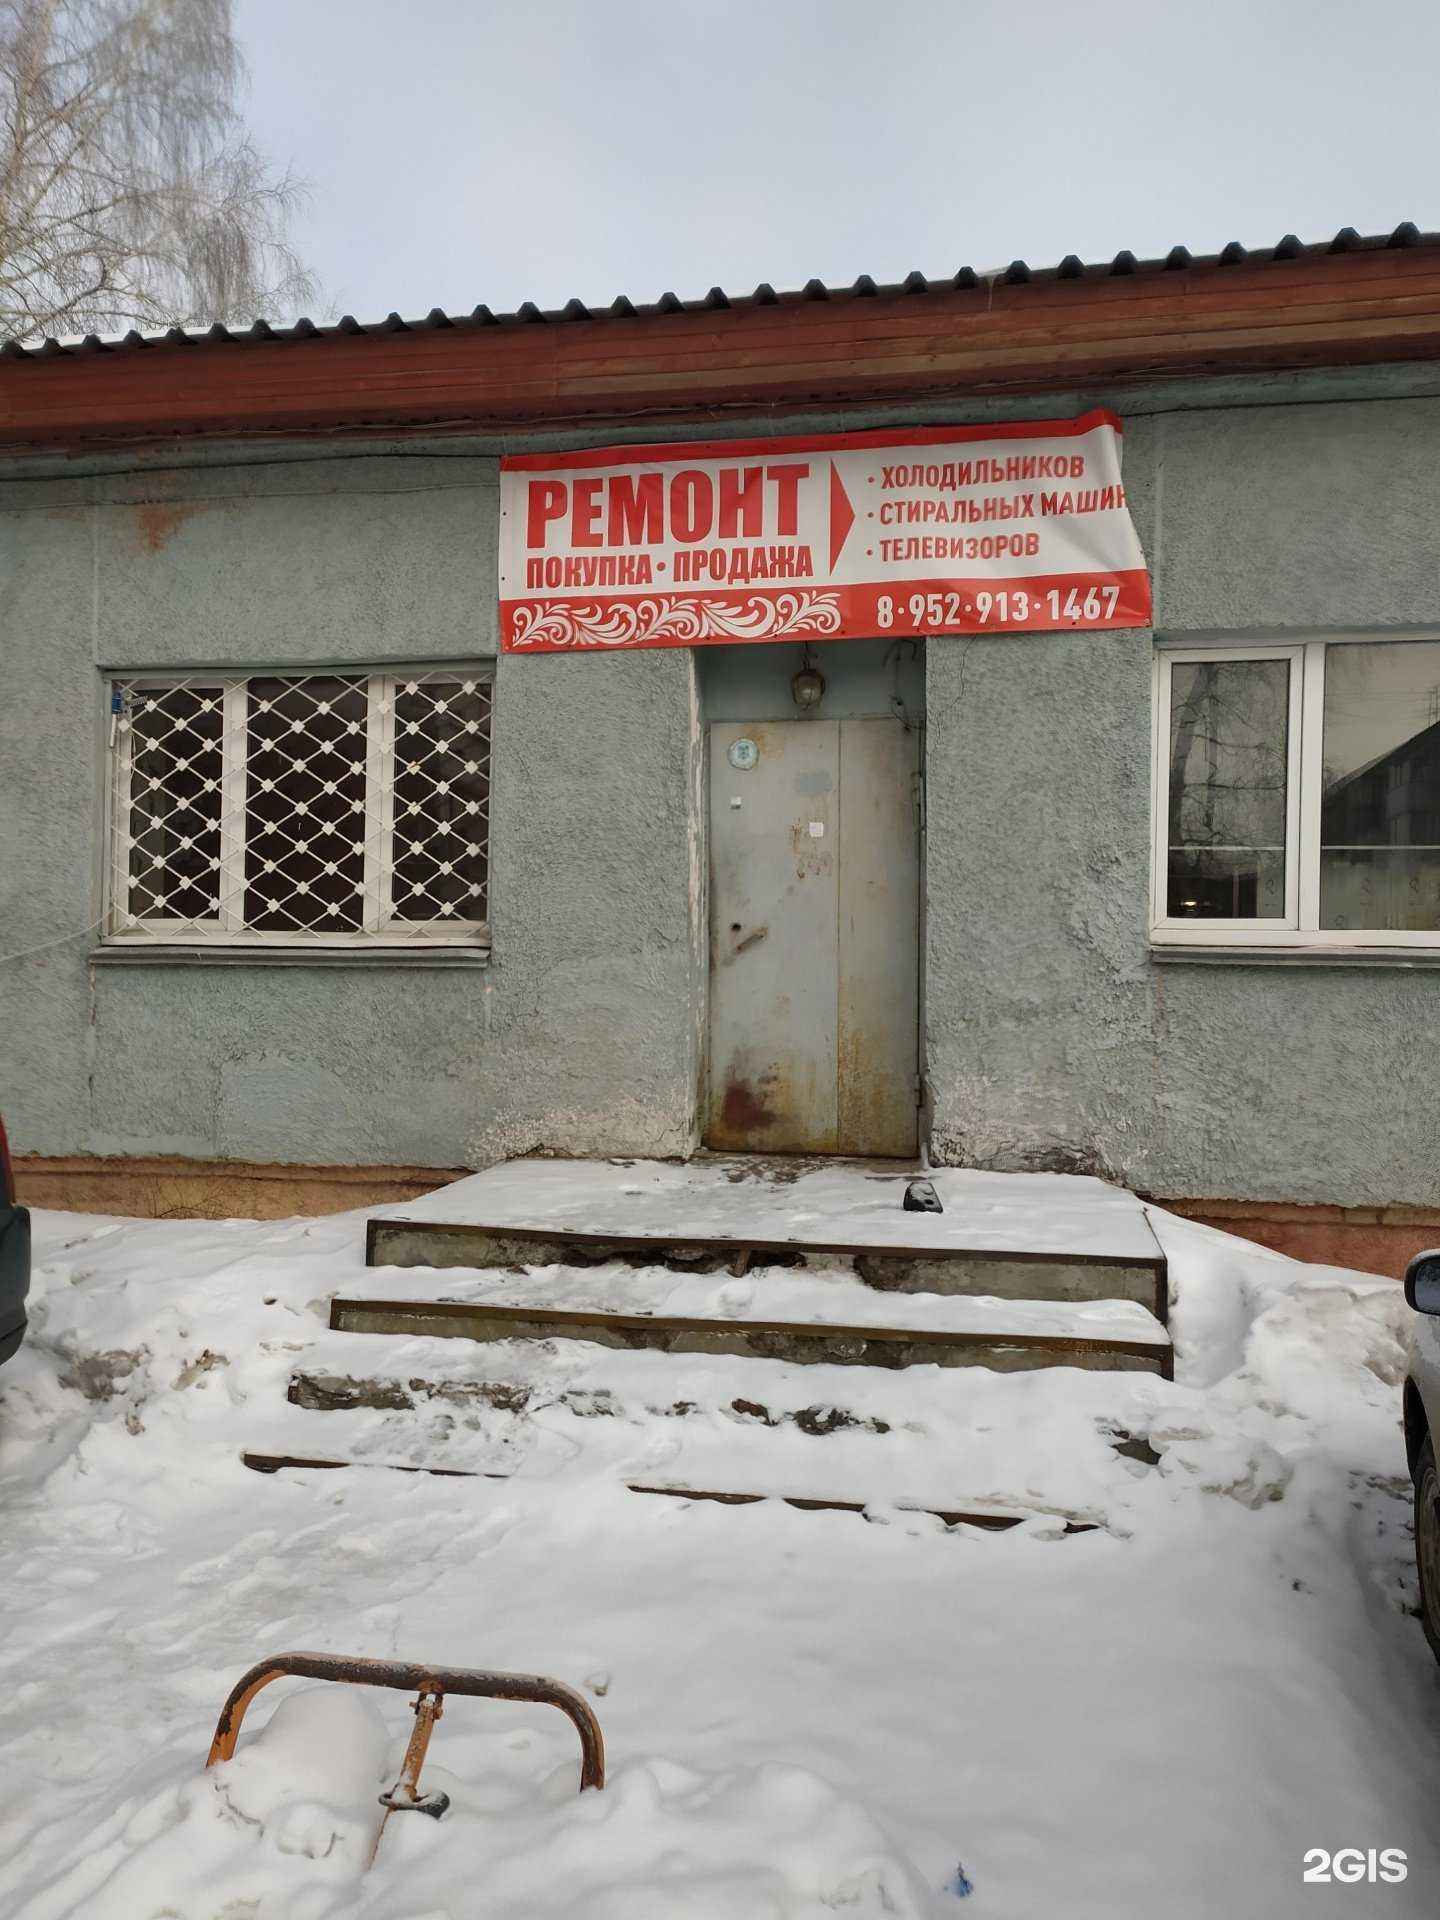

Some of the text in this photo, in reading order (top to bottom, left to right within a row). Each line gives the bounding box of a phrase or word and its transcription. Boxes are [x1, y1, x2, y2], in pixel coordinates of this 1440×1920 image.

[880, 456, 1085, 491] ХОЛОДИЛЬНИКОВ
[527, 463, 810, 548] РЕМОНТ
[880, 493, 1034, 525] СТИРАЛЬНЫХ
[879, 533, 1039, 562] ТЕЛЕВИЗОРОВ
[526, 546, 814, 589] ПОКУПКА ПРОДАЖА
